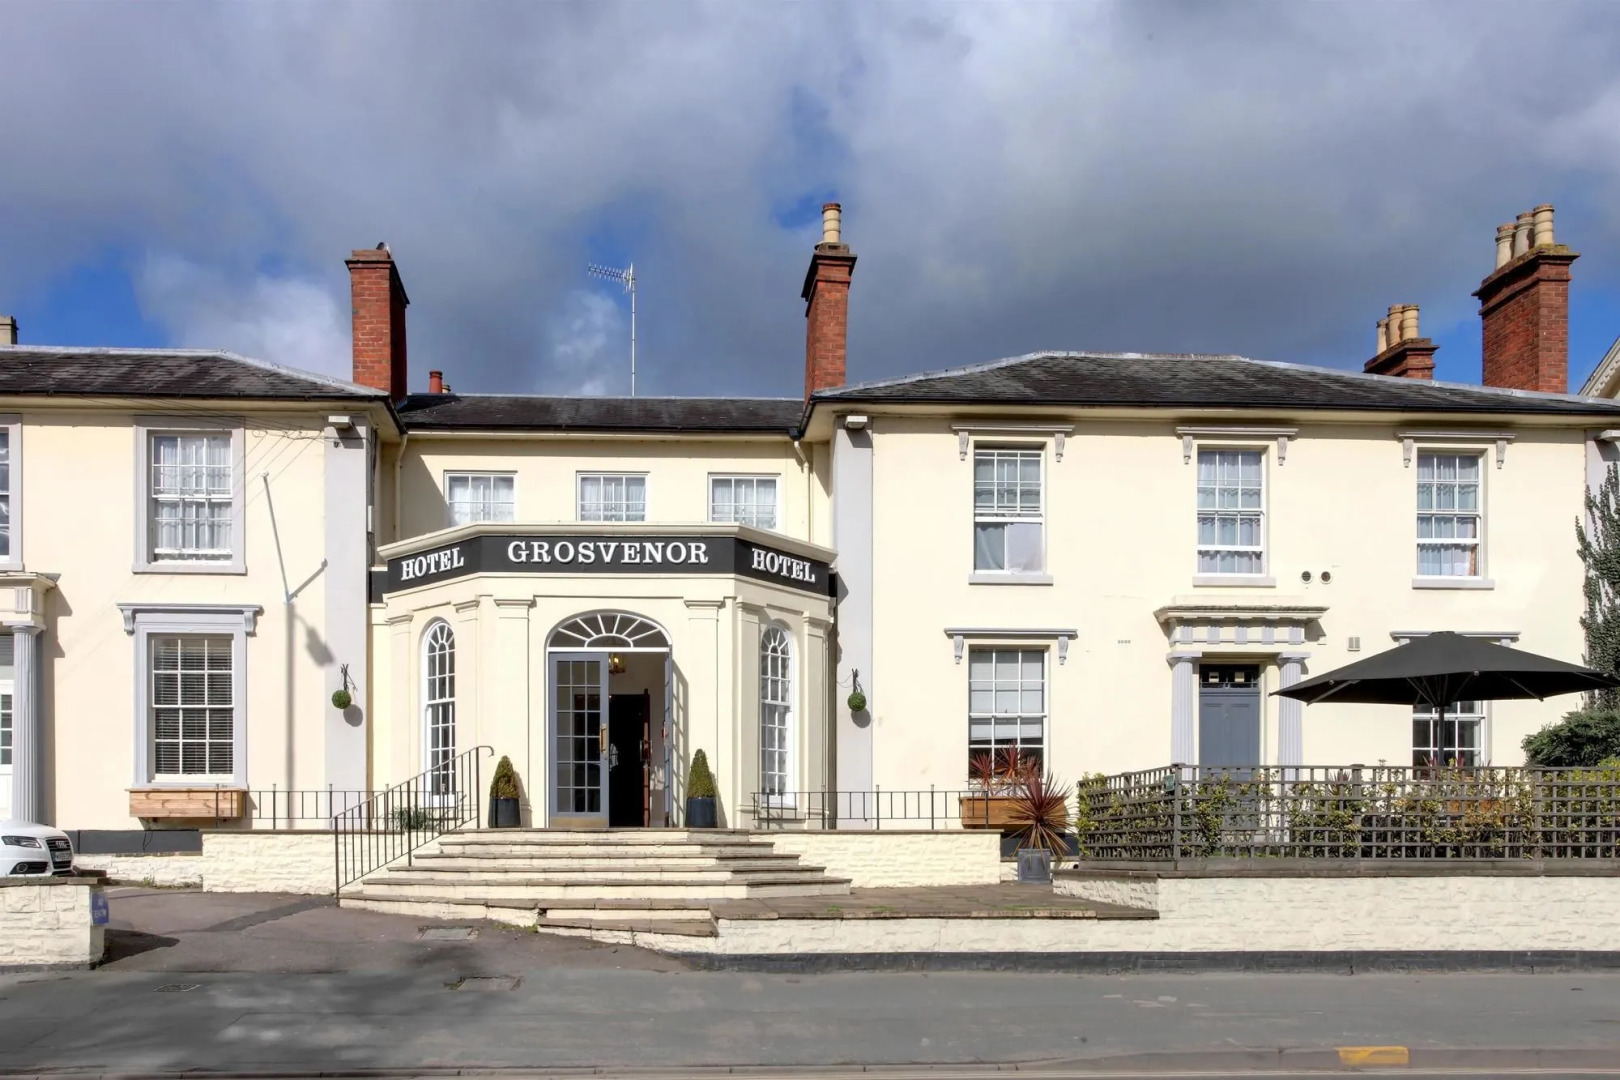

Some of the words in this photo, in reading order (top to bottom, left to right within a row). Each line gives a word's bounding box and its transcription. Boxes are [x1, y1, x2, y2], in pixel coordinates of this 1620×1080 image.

[400, 547, 466, 581] HOTEL
[507, 541, 710, 564] GROSVENOR
[751, 547, 817, 583] HOTEL
